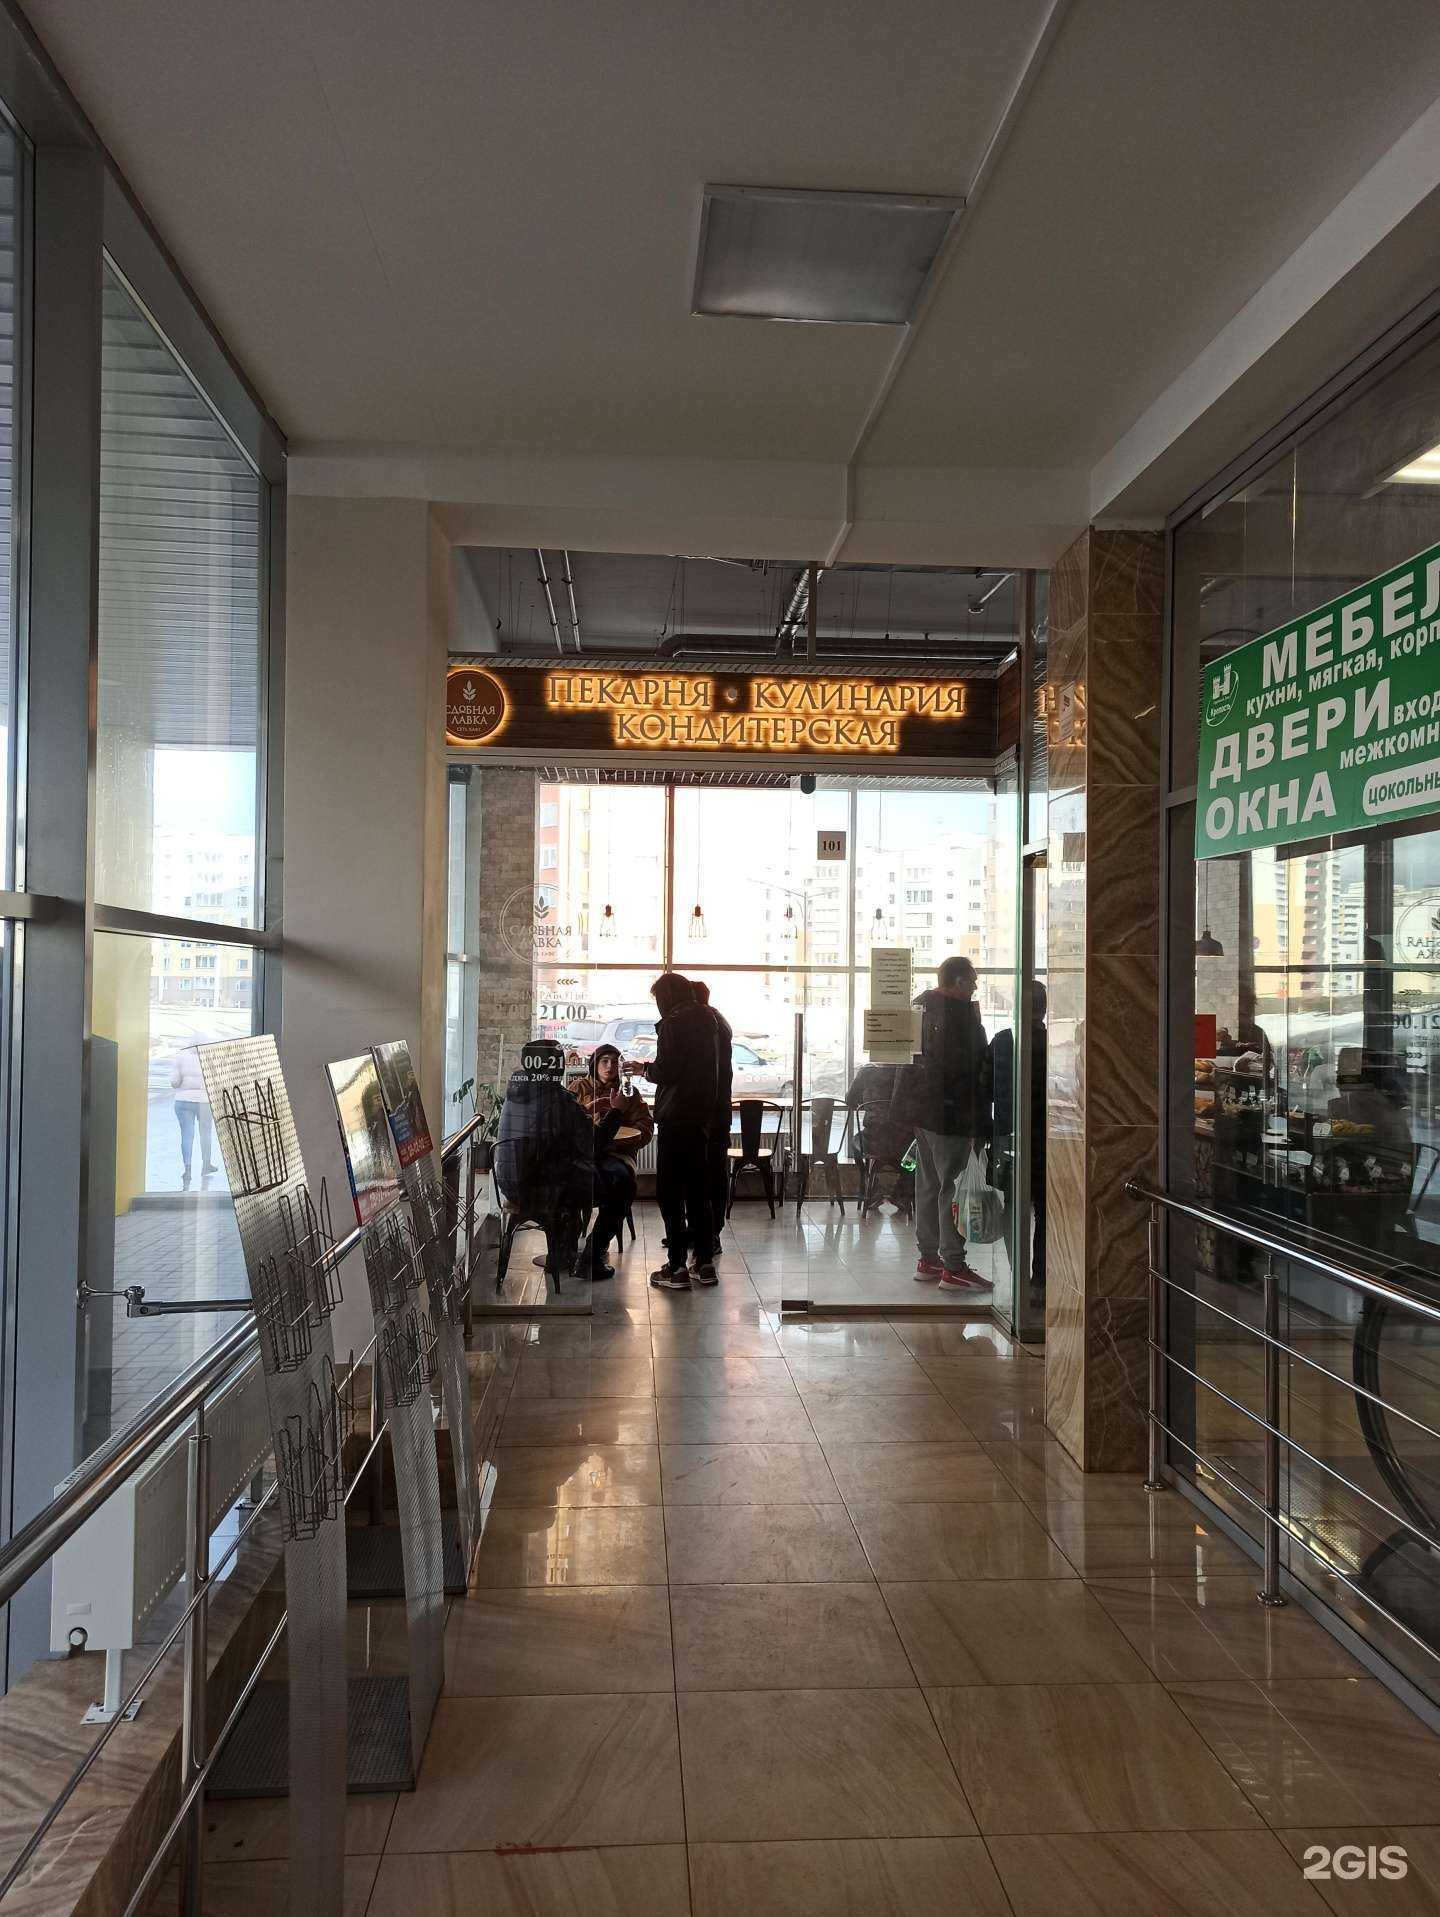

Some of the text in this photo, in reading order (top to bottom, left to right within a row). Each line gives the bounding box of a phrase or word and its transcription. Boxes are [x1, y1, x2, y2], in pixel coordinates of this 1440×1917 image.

[549, 676, 966, 713] ПЕКАРНЯ КУЛИНАРИЯ
[1246, 682, 1302, 718] кухни,
[1308, 648, 1383, 692] мягкая,
[446, 704, 496, 715] СДОБНАЯ
[451, 715, 488, 725] ЛАВКА
[616, 713, 897, 745] КОНДИТЕРСКАЯ
[1209, 677, 1390, 790] ДВЕРИ
[1340, 720, 1440, 770] межкомн
[1205, 770, 1337, 840] ОКНА
[822, 839, 841, 851] 101
